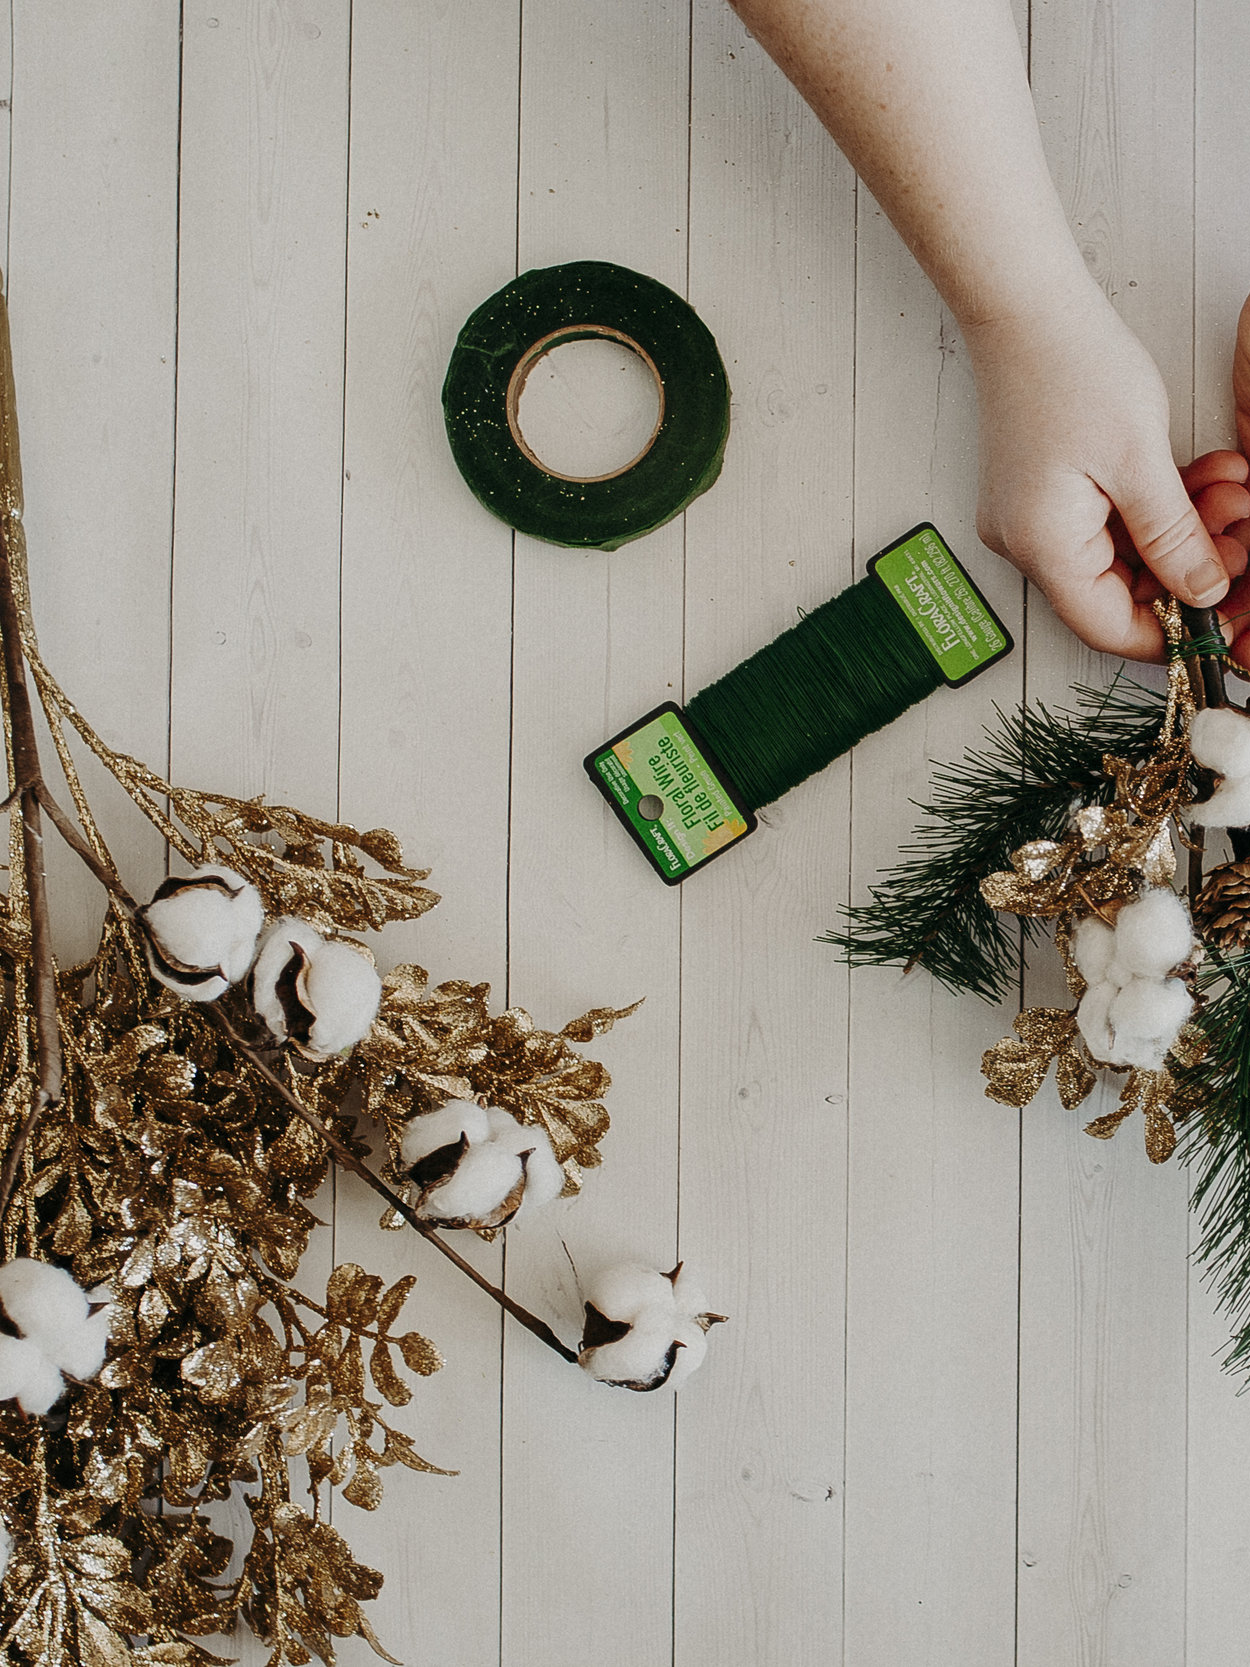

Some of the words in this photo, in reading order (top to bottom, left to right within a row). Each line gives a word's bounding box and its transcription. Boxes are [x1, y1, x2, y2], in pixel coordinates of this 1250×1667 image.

[943, 570, 960, 587] 270
[960, 594, 984, 623] (Calibre
[975, 617, 998, 642] Gauge
[988, 638, 1003, 651] 26
[643, 754, 675, 791] Wire
[652, 735, 700, 795] fleuriste
[665, 786, 701, 830] Floral
[689, 790, 712, 813] de
[702, 809, 724, 831] Fil
[671, 827, 697, 860] Design
